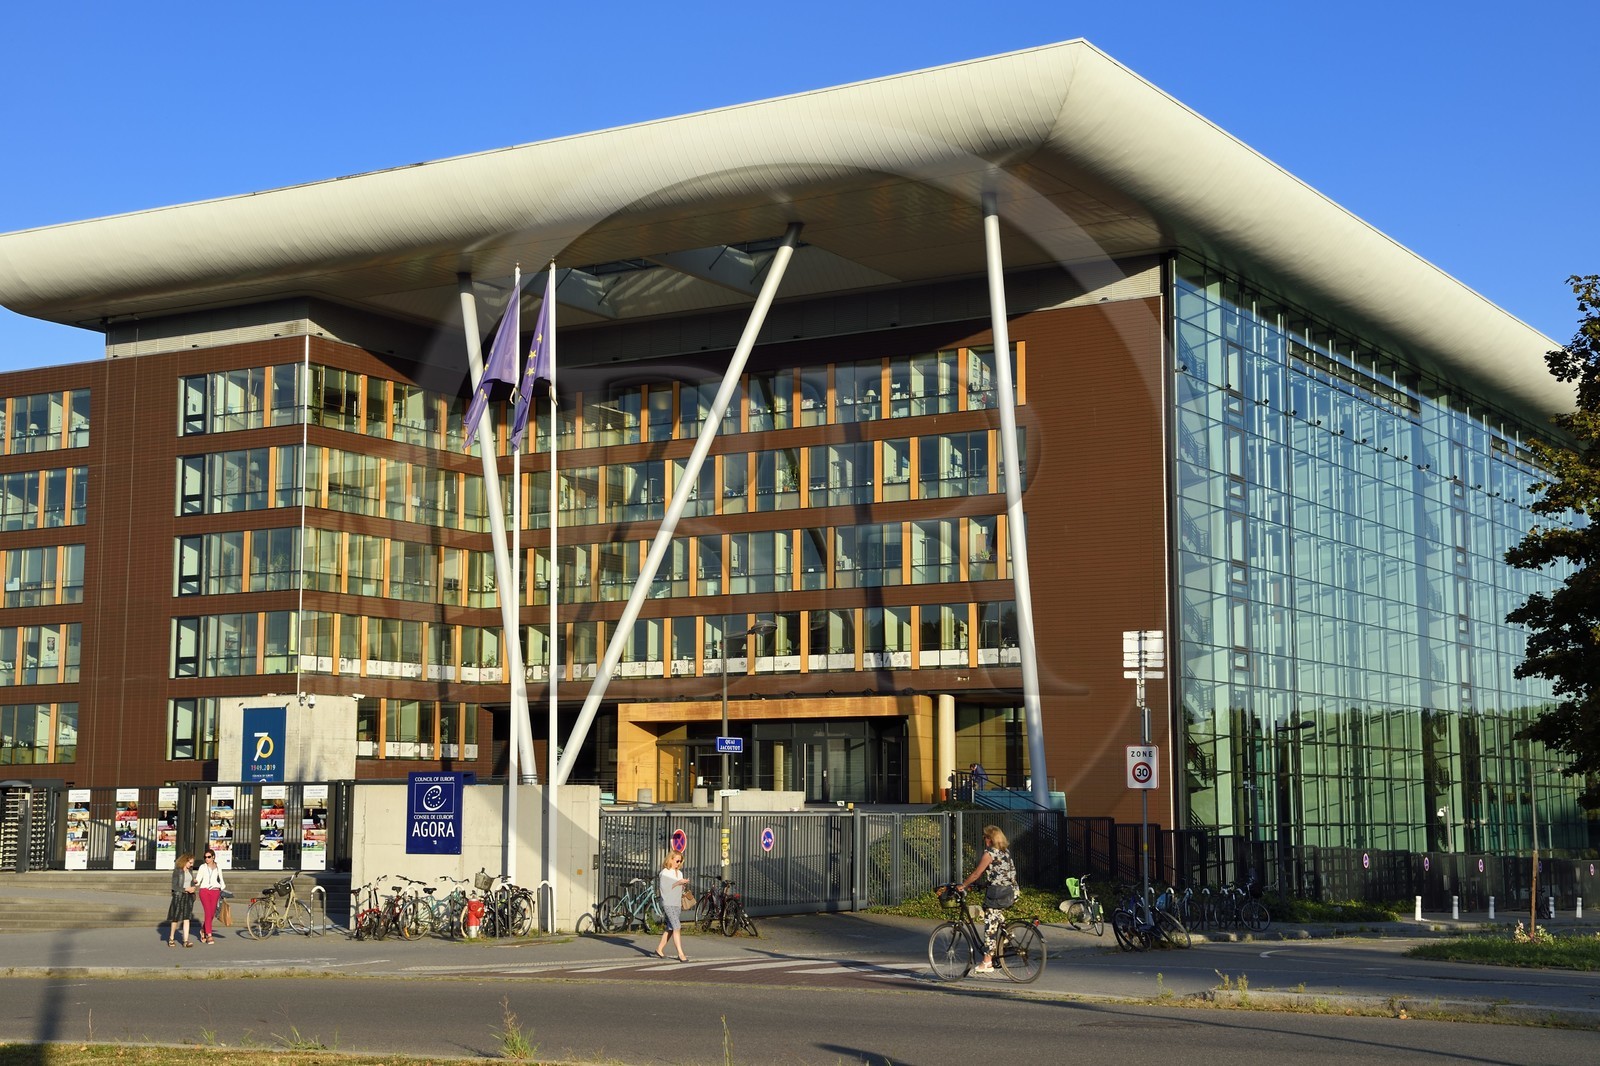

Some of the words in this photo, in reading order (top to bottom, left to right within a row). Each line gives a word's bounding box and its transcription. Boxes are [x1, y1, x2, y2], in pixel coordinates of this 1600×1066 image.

[253, 732, 274, 762] 70
[1136, 768, 1148, 777] 30
[412, 821, 455, 838] AGORA
